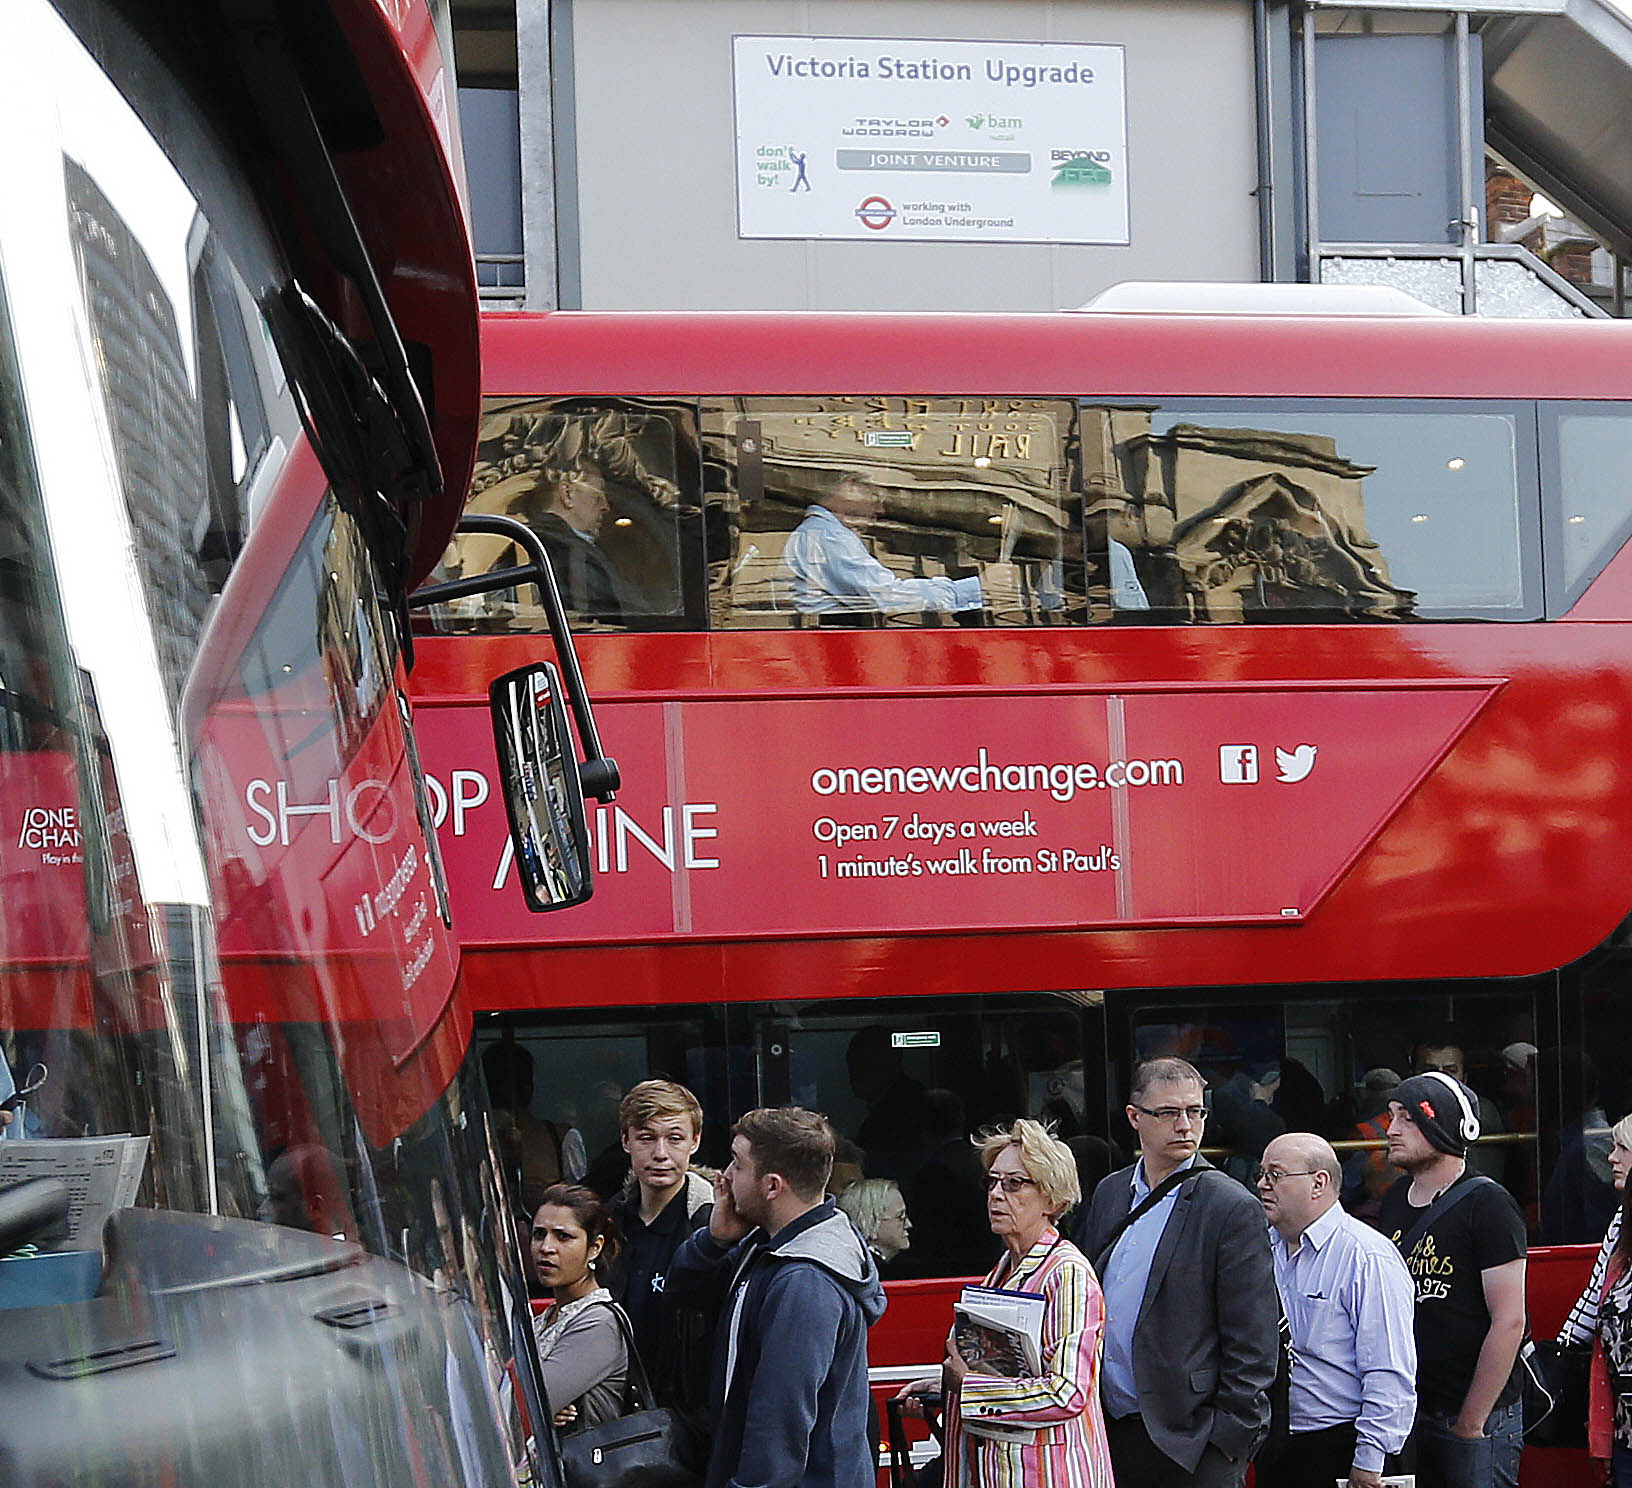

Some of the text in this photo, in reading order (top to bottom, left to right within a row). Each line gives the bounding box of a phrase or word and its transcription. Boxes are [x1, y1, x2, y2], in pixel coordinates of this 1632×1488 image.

[766, 54, 1096, 89] Victoria Station Upgrade
[855, 117, 934, 128] TAYLOR
[987, 113, 1023, 129] bam
[841, 128, 934, 137] WOODROW
[756, 145, 794, 158] don't
[1050, 149, 1111, 163] BEYOND
[756, 159, 791, 172] walk
[868, 152, 1001, 169] JOINT VENTURE
[757, 173, 779, 188] by!
[902, 202, 944, 214] working
[946, 202, 972, 212] with
[902, 215, 1014, 230] London Underground
[810, 748, 1184, 801] onenewchange.com
[28, 807, 75, 828] ONE
[812, 810, 1038, 847] Open 7 days a week
[817, 845, 1121, 878] 1 minute's walk from St Paul's
[1416, 1277, 1452, 1298] 1975
